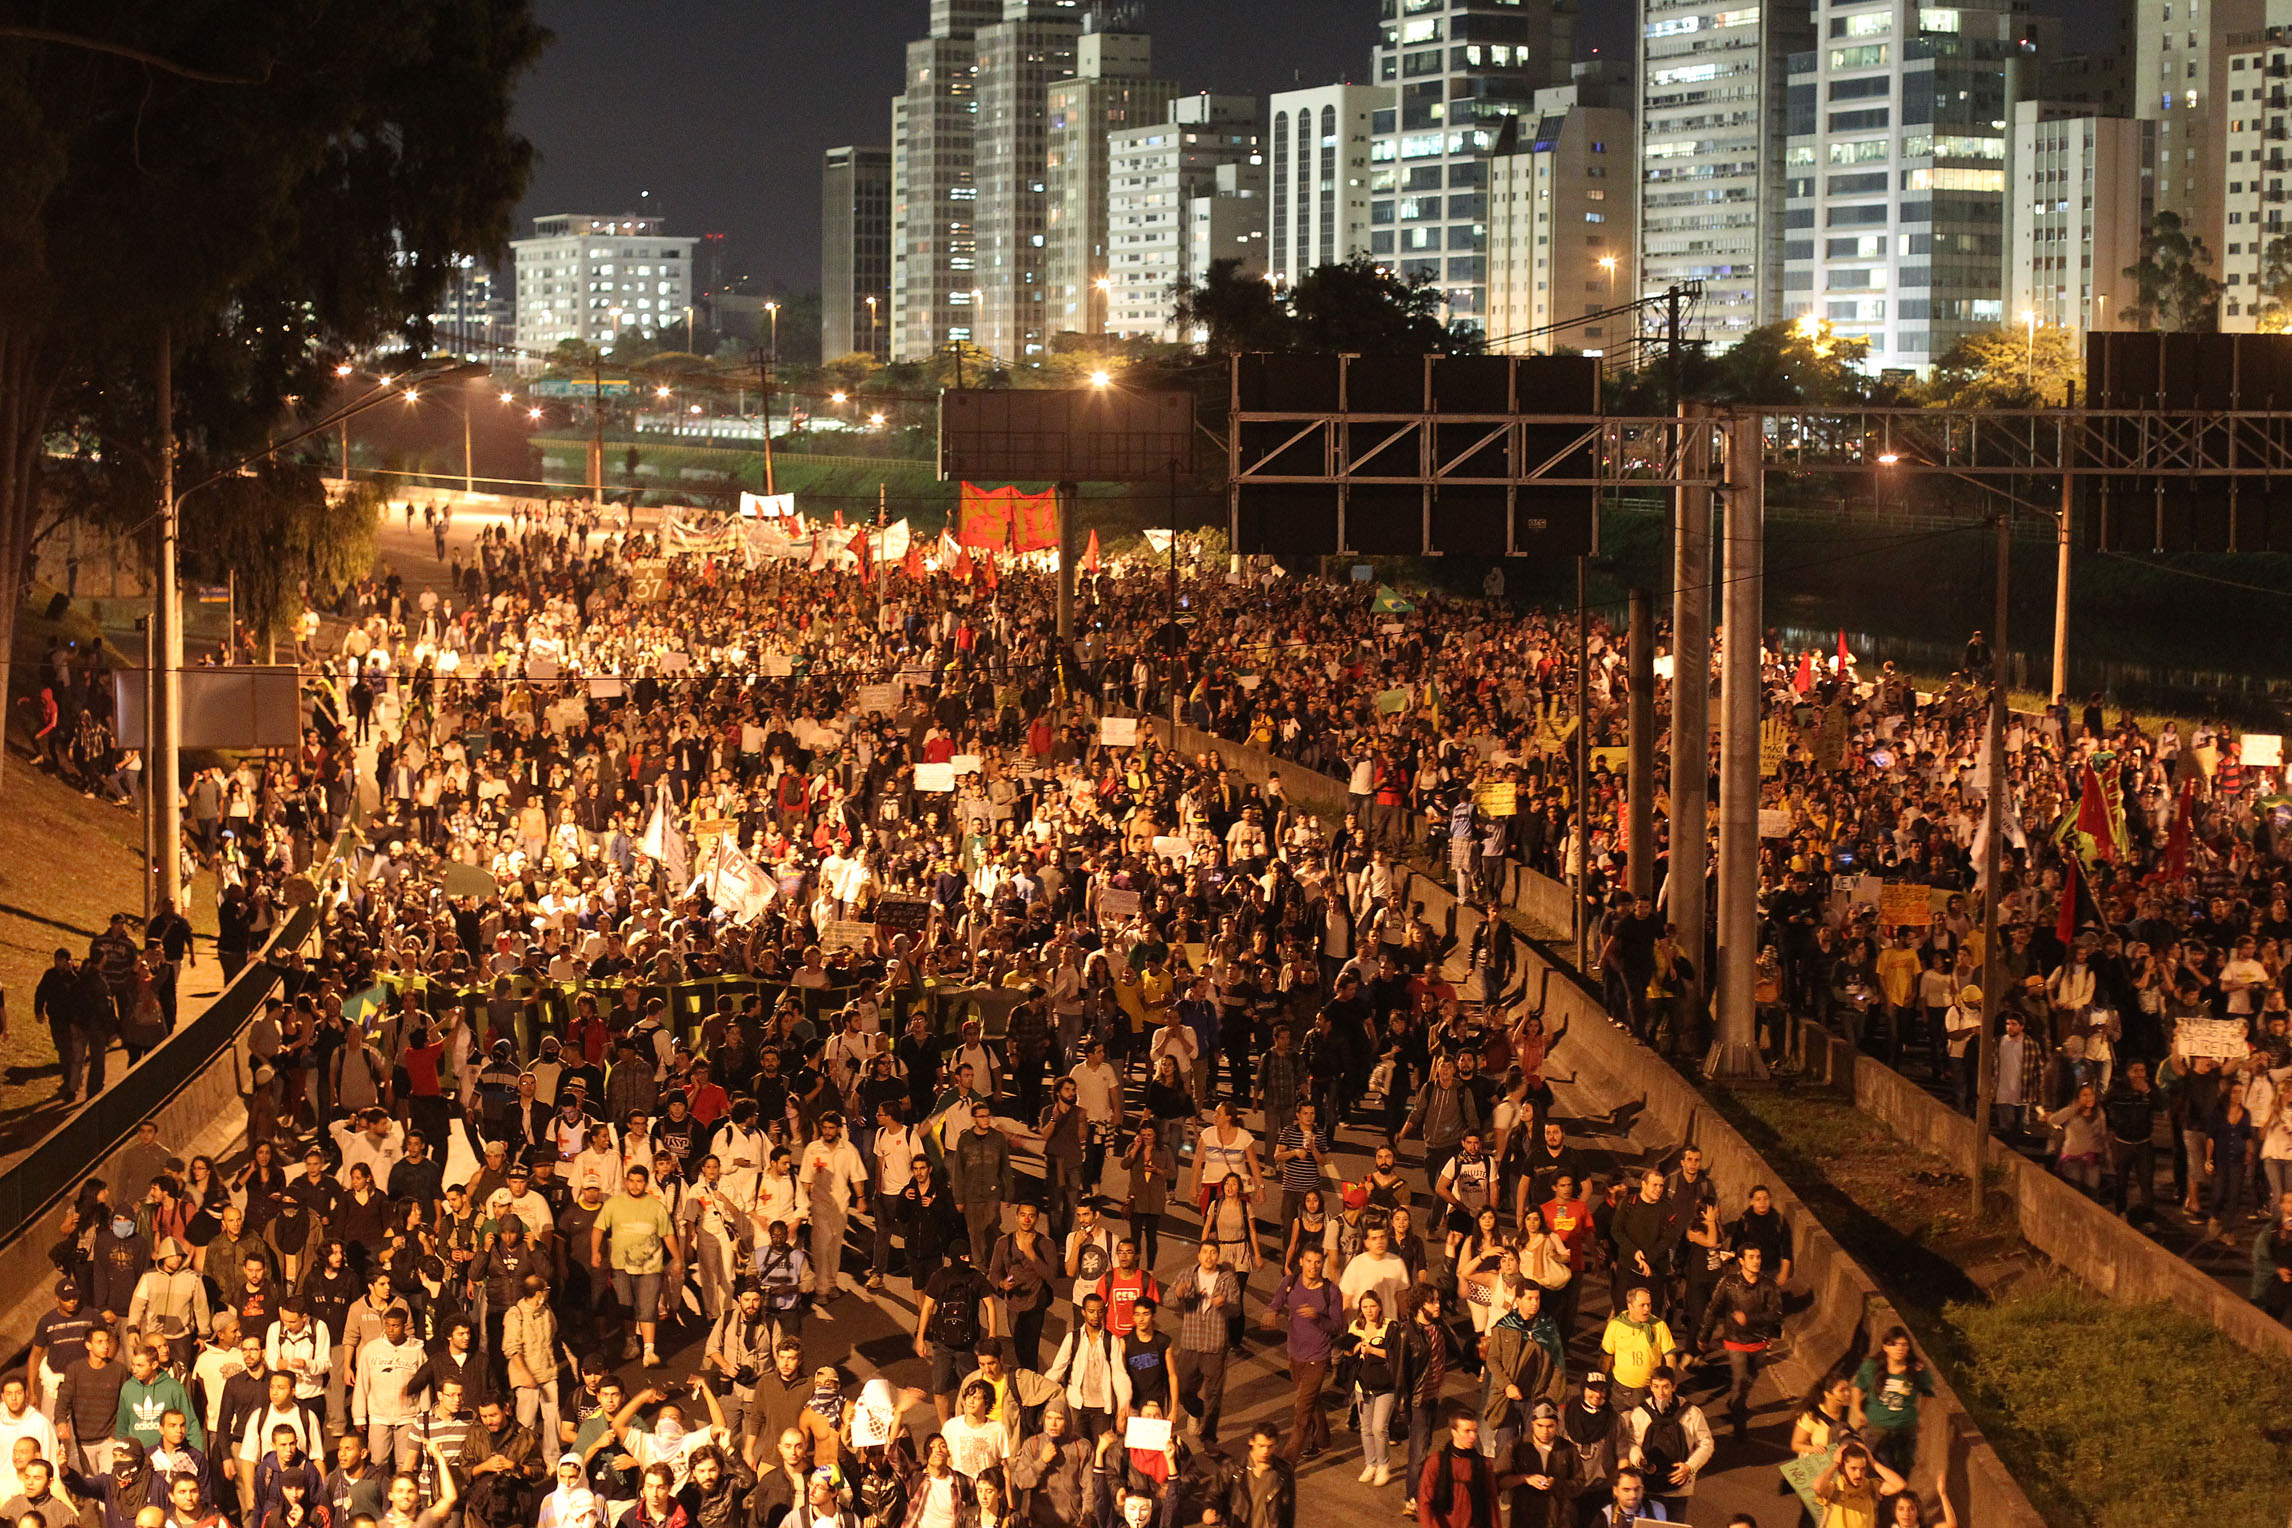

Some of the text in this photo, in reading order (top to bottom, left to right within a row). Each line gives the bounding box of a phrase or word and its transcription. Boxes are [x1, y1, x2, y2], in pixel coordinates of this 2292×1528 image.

[634, 578, 662, 599] 37
[1461, 1169, 1488, 1179] HOLLISTE
[1632, 1351, 1643, 1367] 18
[134, 1420, 161, 1431] adida
